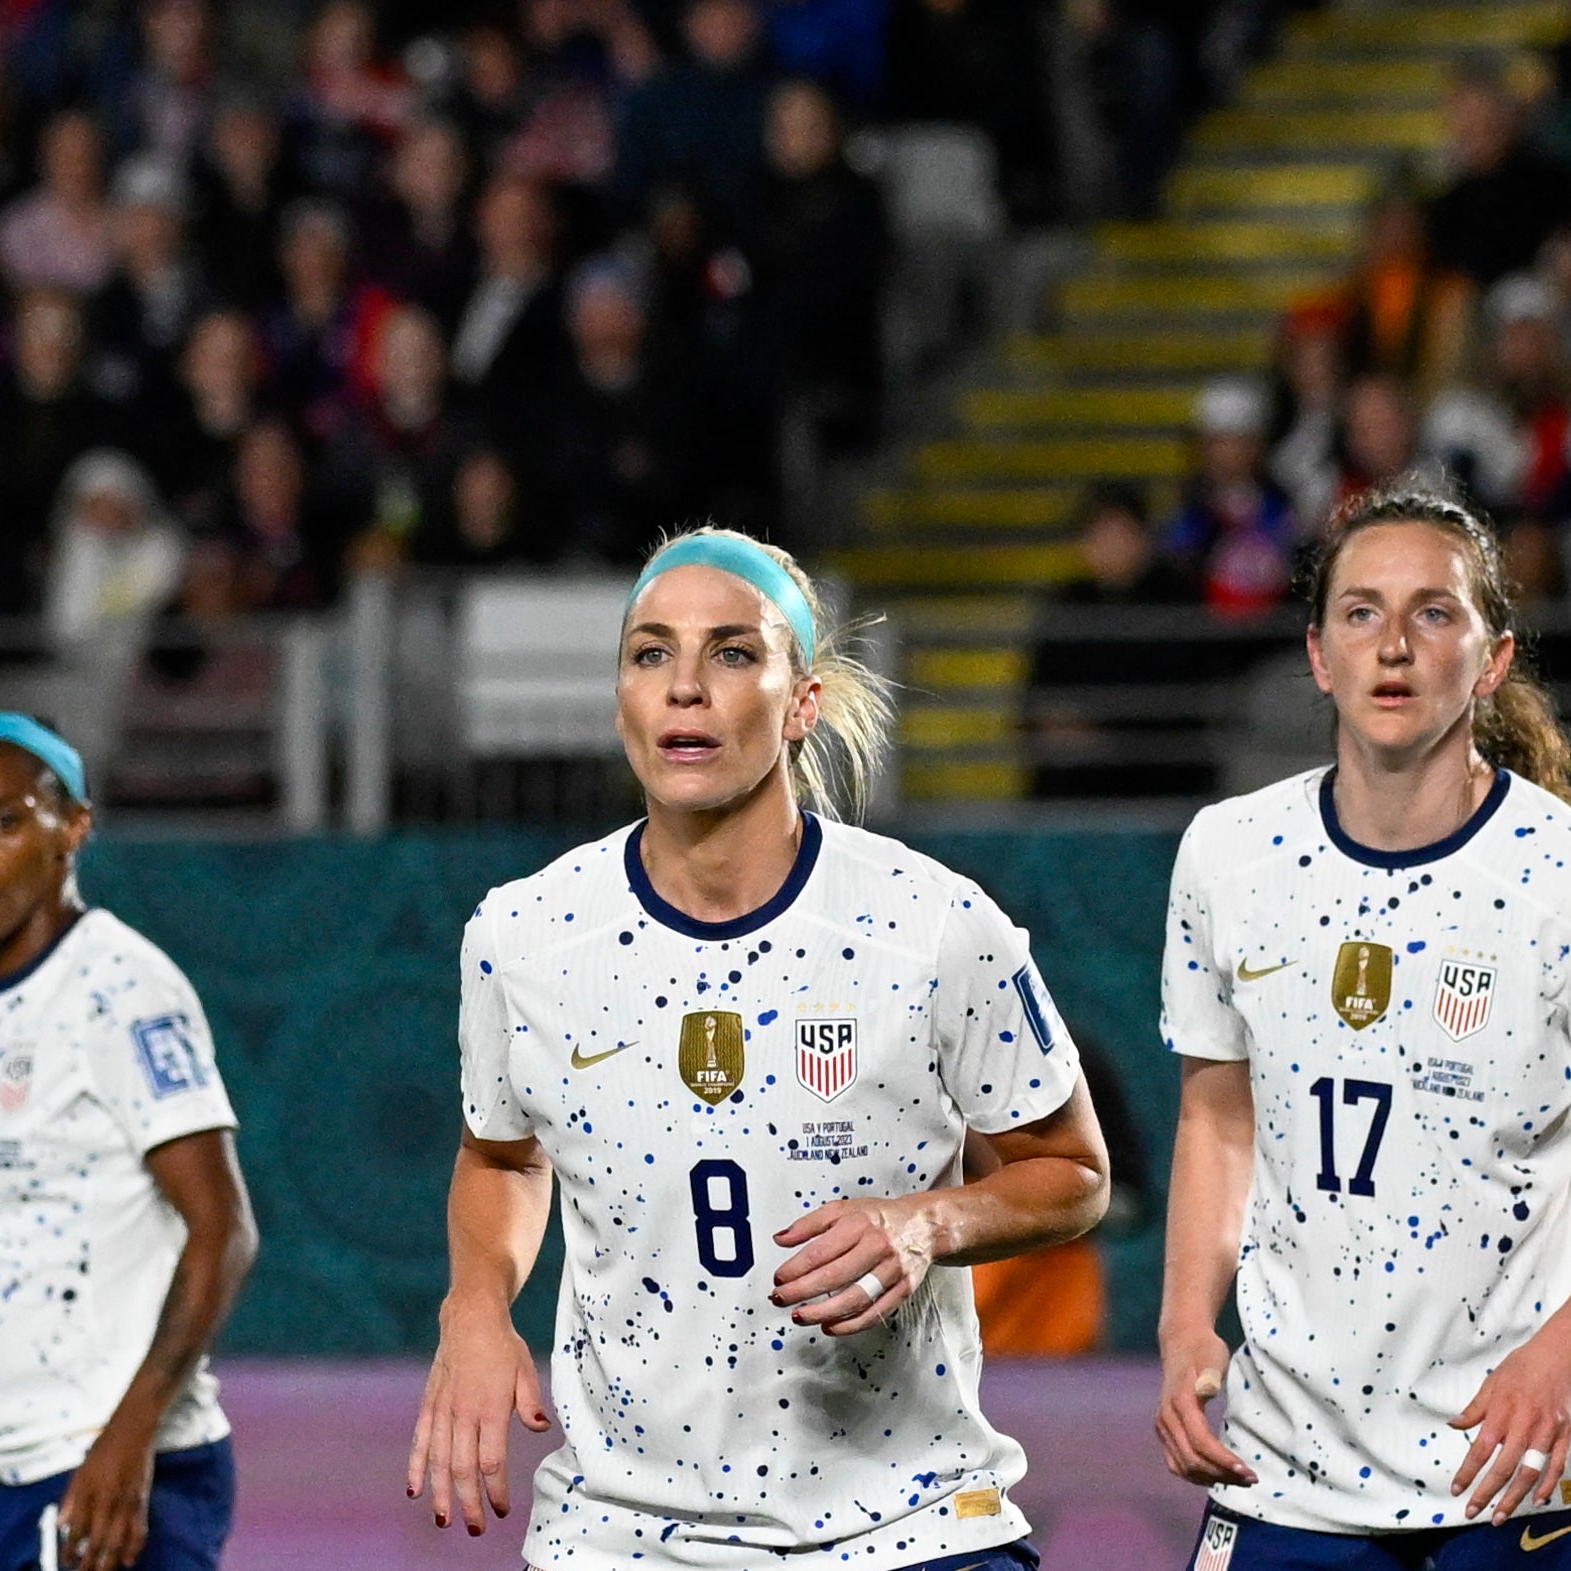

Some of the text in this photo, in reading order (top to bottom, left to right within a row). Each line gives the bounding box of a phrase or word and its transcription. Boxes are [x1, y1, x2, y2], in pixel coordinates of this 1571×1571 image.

[1444, 965, 1492, 997] USA
[1345, 996, 1374, 1010] FIFA
[801, 1024, 852, 1055] USA
[696, 1070, 728, 1083] FIFA
[704, 1087, 722, 1095] 2019
[802, 1122, 815, 1134] USA
[823, 1121, 855, 1133] PORTUGAL
[810, 1135, 835, 1147] AUGUST
[836, 1134, 853, 1146] 2023
[1309, 1076, 1393, 1198] 17
[841, 1145, 868, 1159] ZEALAND
[689, 1159, 754, 1278] 8
[1207, 1520, 1234, 1550] USA
